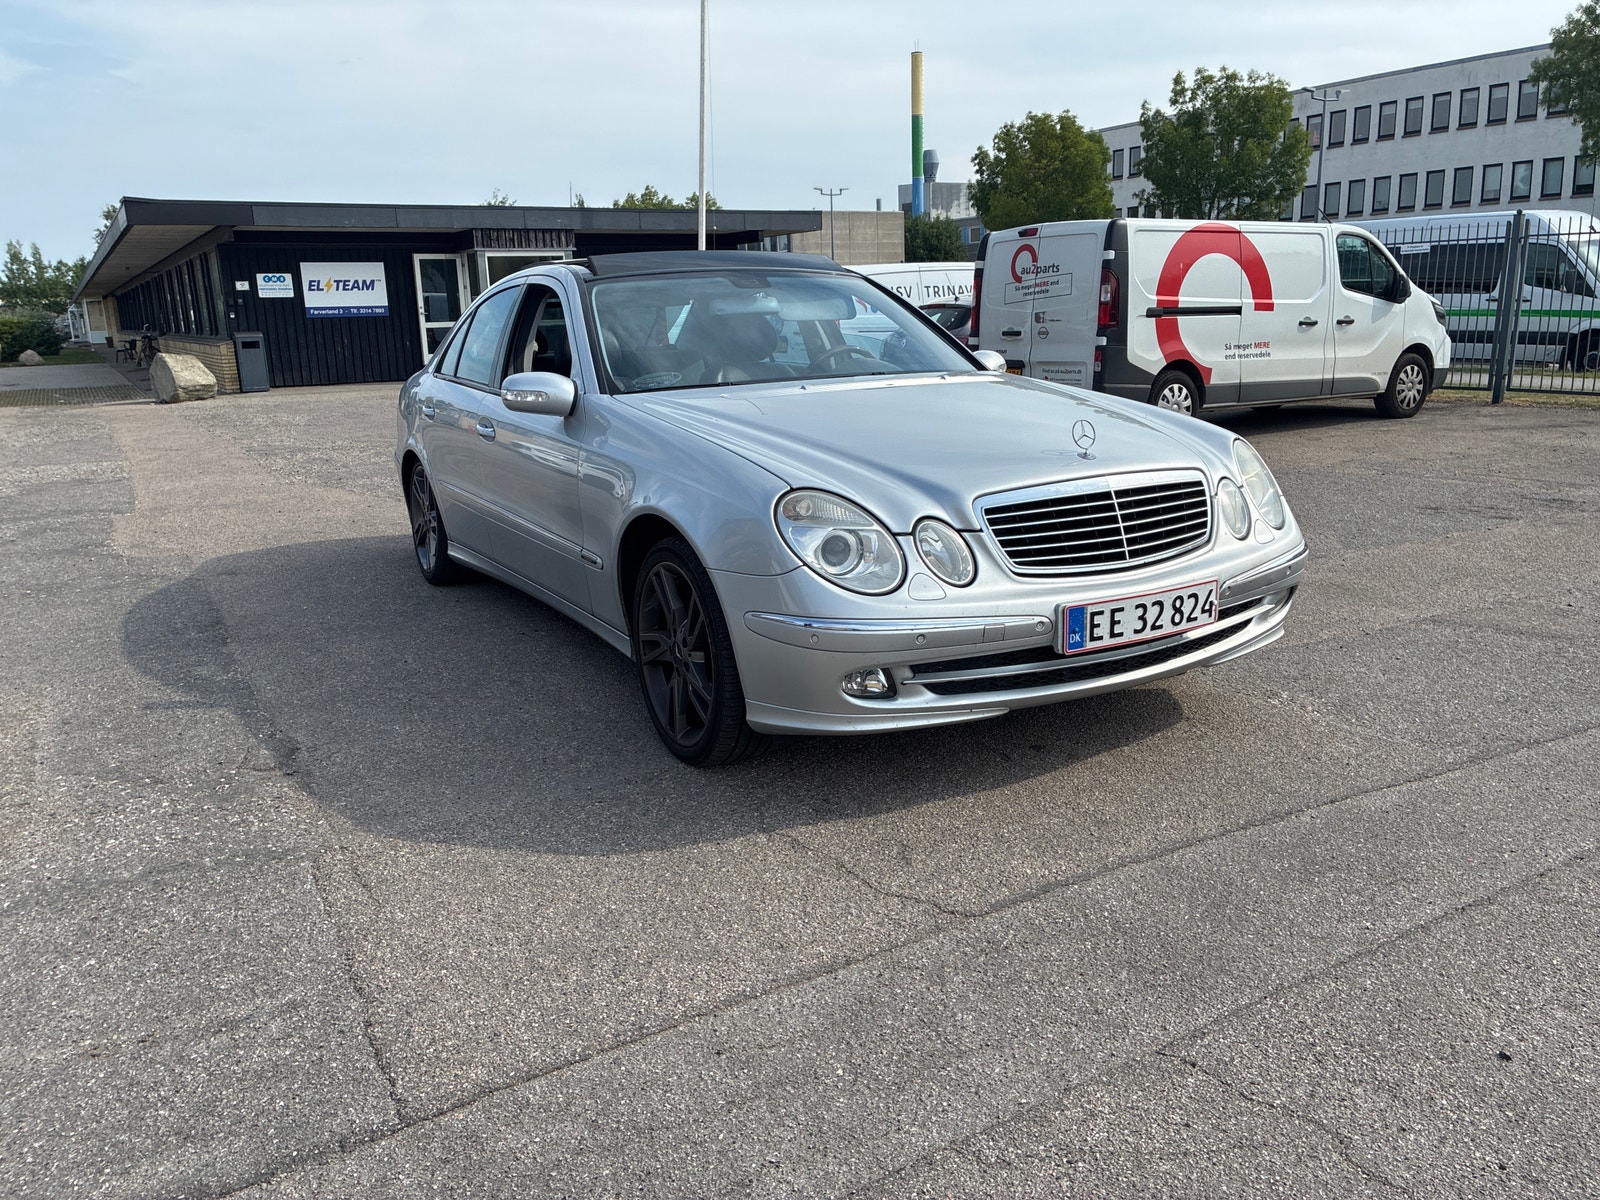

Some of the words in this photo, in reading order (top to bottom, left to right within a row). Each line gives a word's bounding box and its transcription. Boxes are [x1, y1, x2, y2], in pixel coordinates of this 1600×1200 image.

[1021, 263, 1060, 276] au2parts
[263, 275, 286, 283] CMS
[334, 280, 375, 291] TEAM
[891, 286, 912, 298] SV
[1233, 343, 1252, 351] meget
[1254, 341, 1270, 349] MERE
[1225, 352, 1236, 360] end
[1237, 351, 1271, 360] reservedele
[1070, 633, 1081, 643] DK
[1089, 607, 1124, 642] EE
[1133, 600, 1164, 634] 32
[1171, 588, 1214, 626] 824
